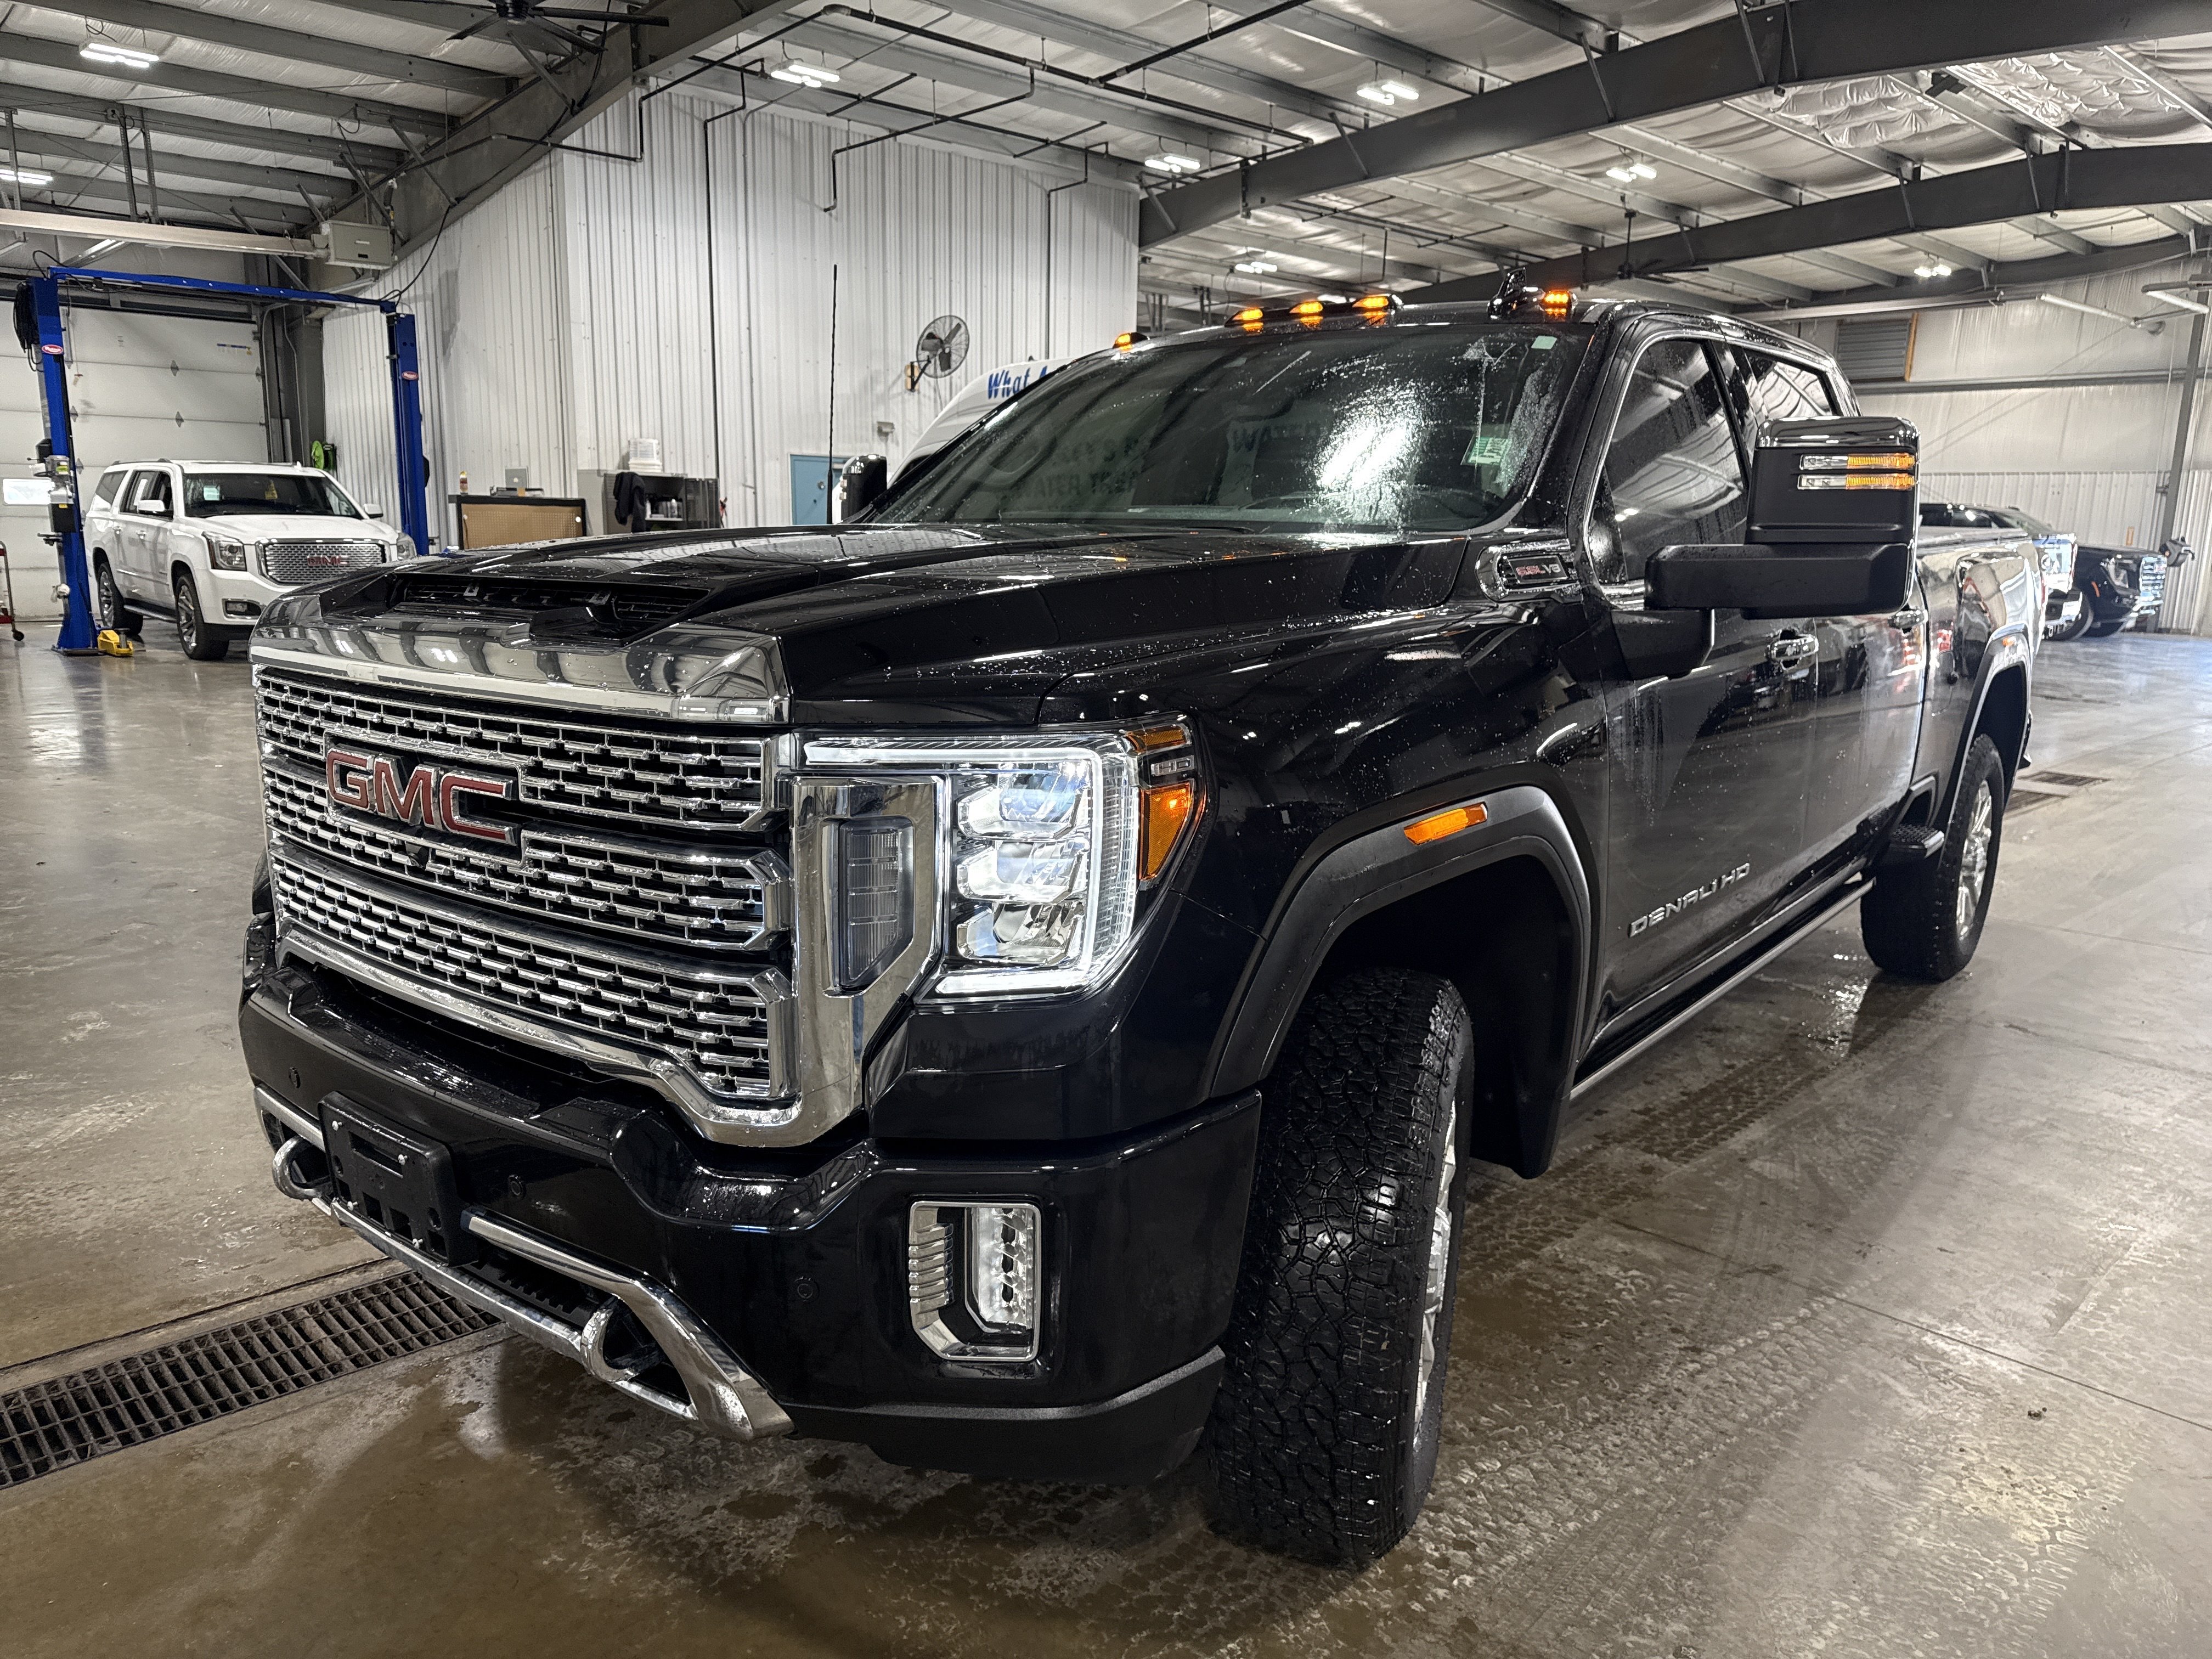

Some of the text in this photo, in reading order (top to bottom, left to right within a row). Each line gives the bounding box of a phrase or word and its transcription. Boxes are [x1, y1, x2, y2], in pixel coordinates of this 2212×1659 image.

[988, 367, 1031, 400] What
[1541, 563, 1561, 574] V8
[326, 748, 517, 847] GMC
[1628, 862, 1750, 938] DENALI HD
